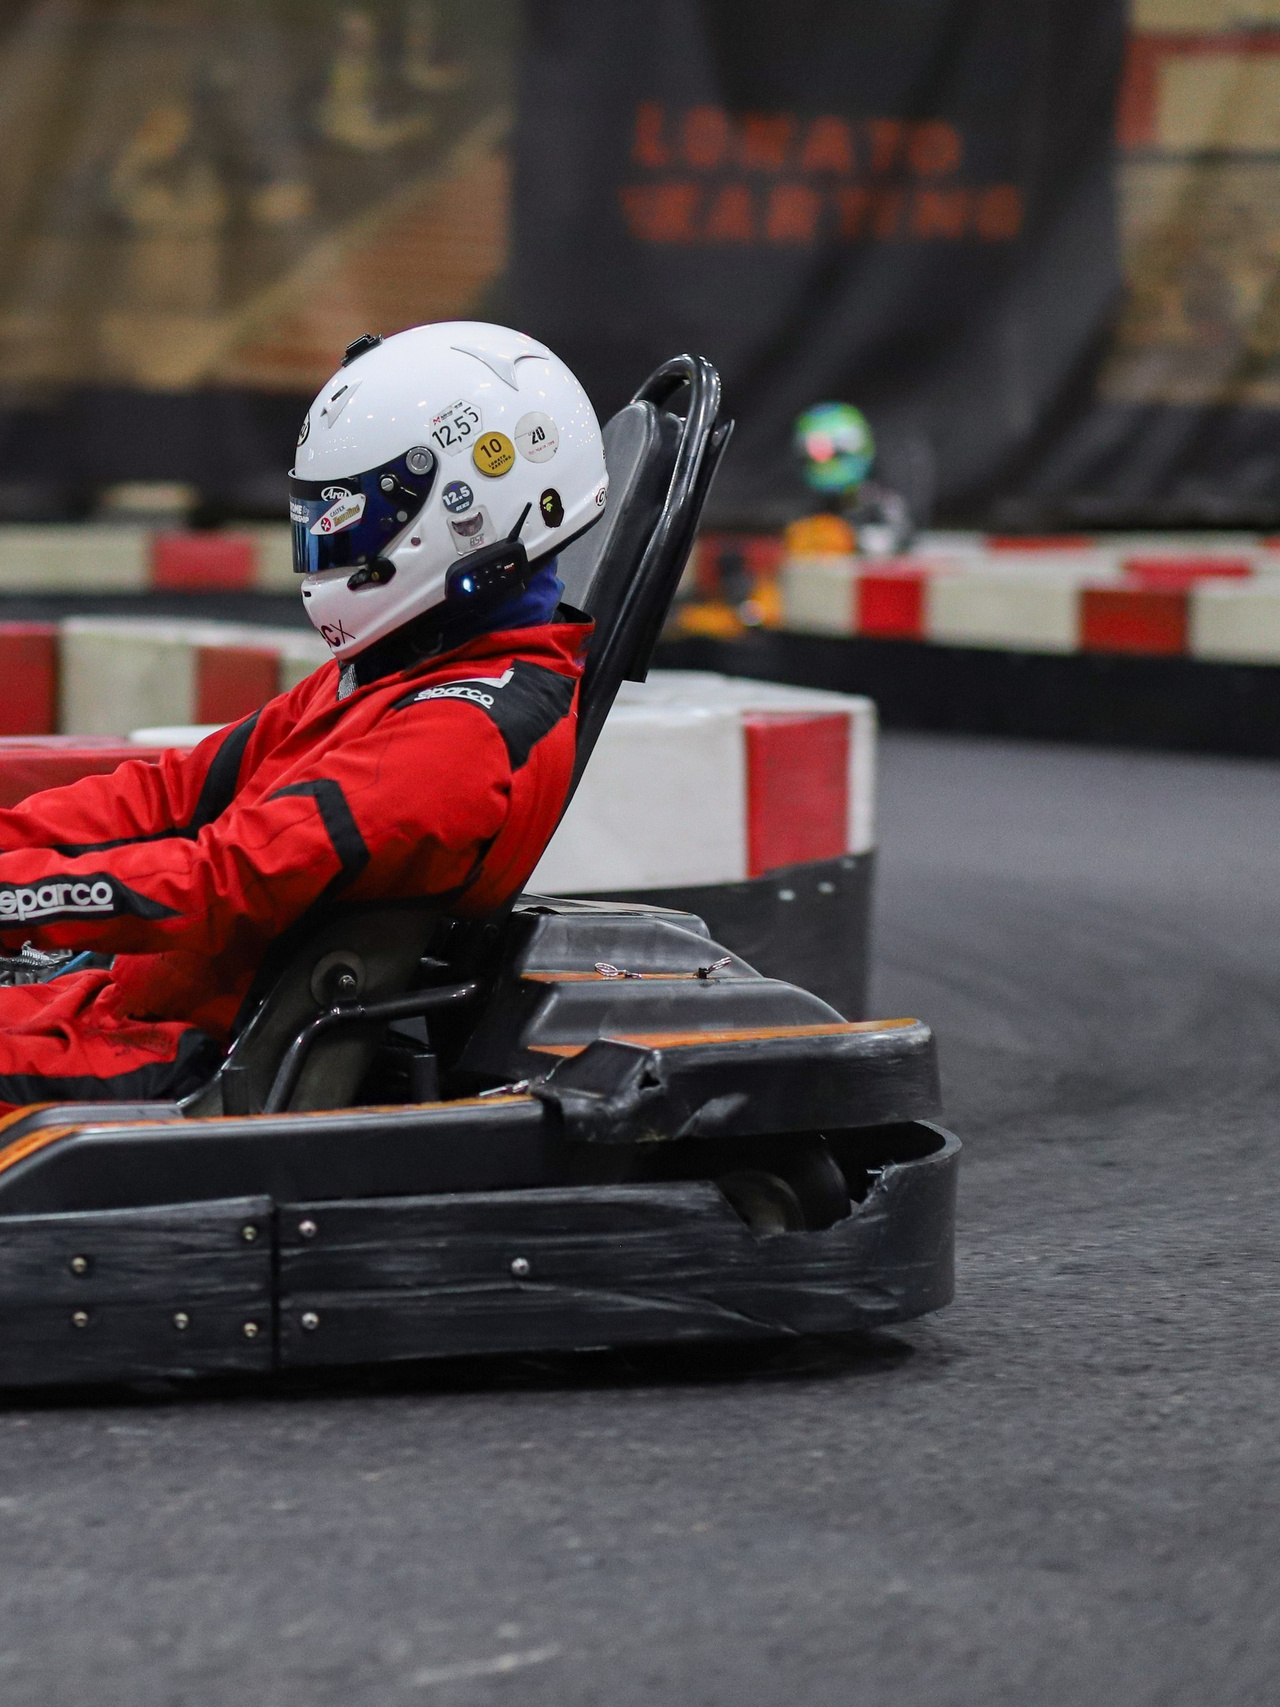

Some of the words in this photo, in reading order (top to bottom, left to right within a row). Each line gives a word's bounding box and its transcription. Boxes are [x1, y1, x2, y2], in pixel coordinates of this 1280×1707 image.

[531, 426, 546, 445] 20
[480, 438, 502, 458] 10
[442, 485, 471, 506] 12.5
[329, 504, 346, 518] CALTEX
[415, 685, 495, 709] sparco
